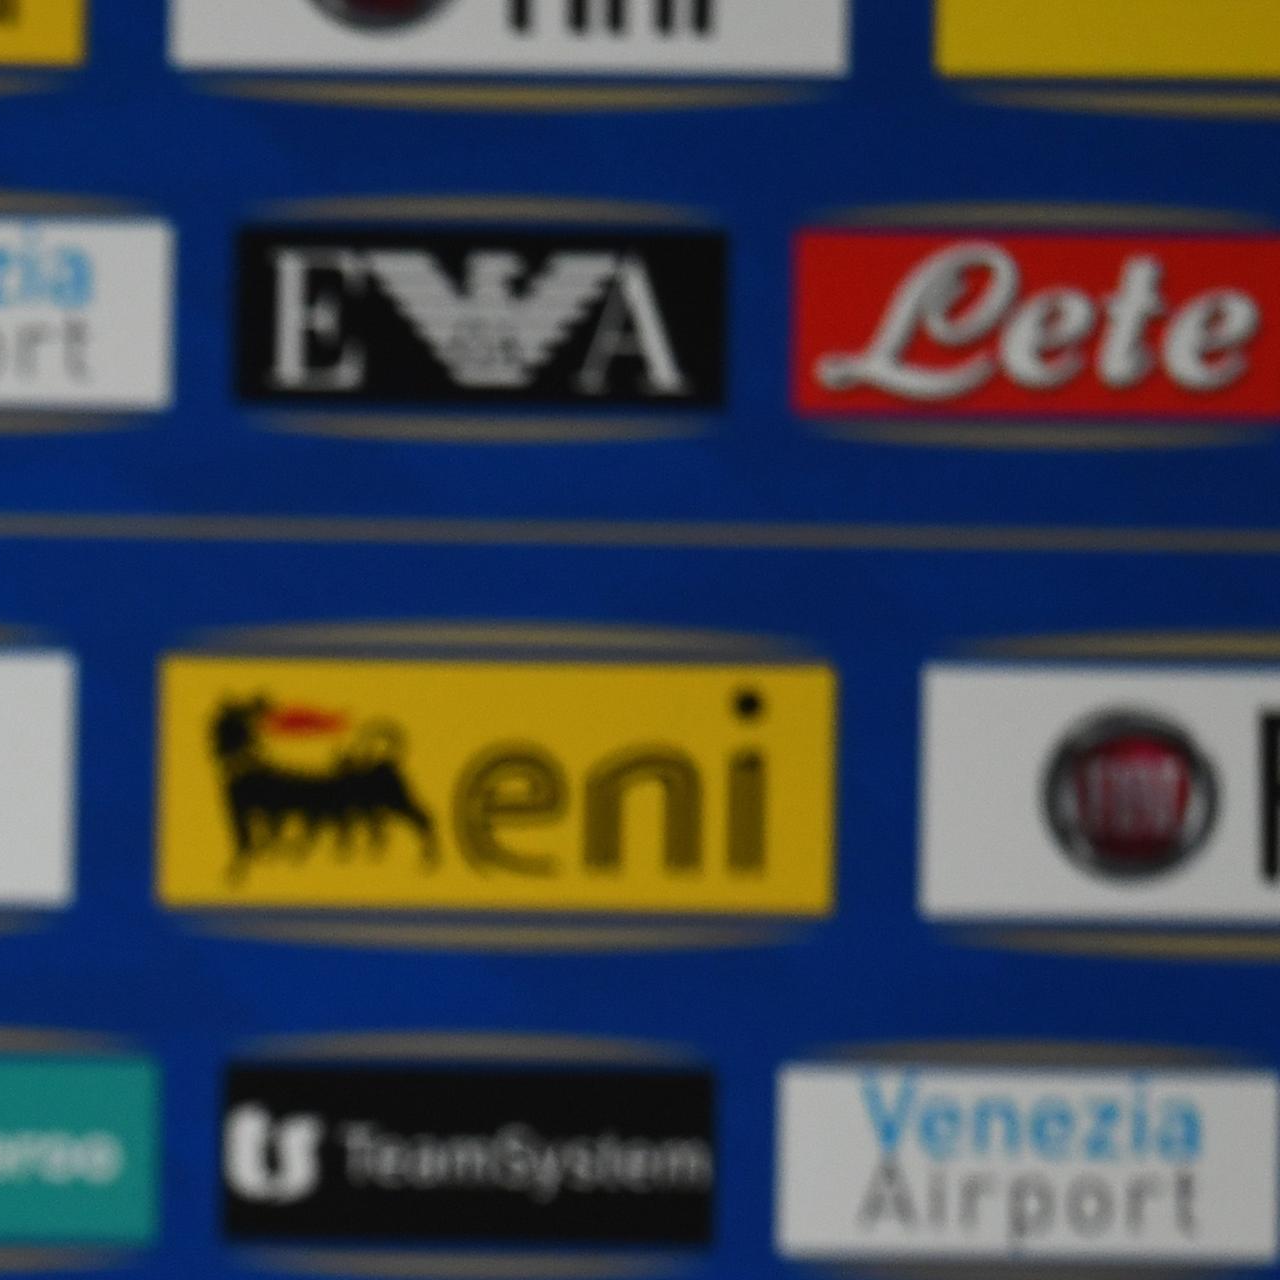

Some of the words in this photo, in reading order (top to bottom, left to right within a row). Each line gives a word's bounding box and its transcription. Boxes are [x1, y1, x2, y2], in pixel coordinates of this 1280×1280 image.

[813, 243, 1260, 400] Lete
[452, 686, 770, 878] eni
[340, 1122, 712, 1200] TeamSystem
[860, 1072, 1204, 1162] Venezia
[854, 1154, 1202, 1246] Airport
